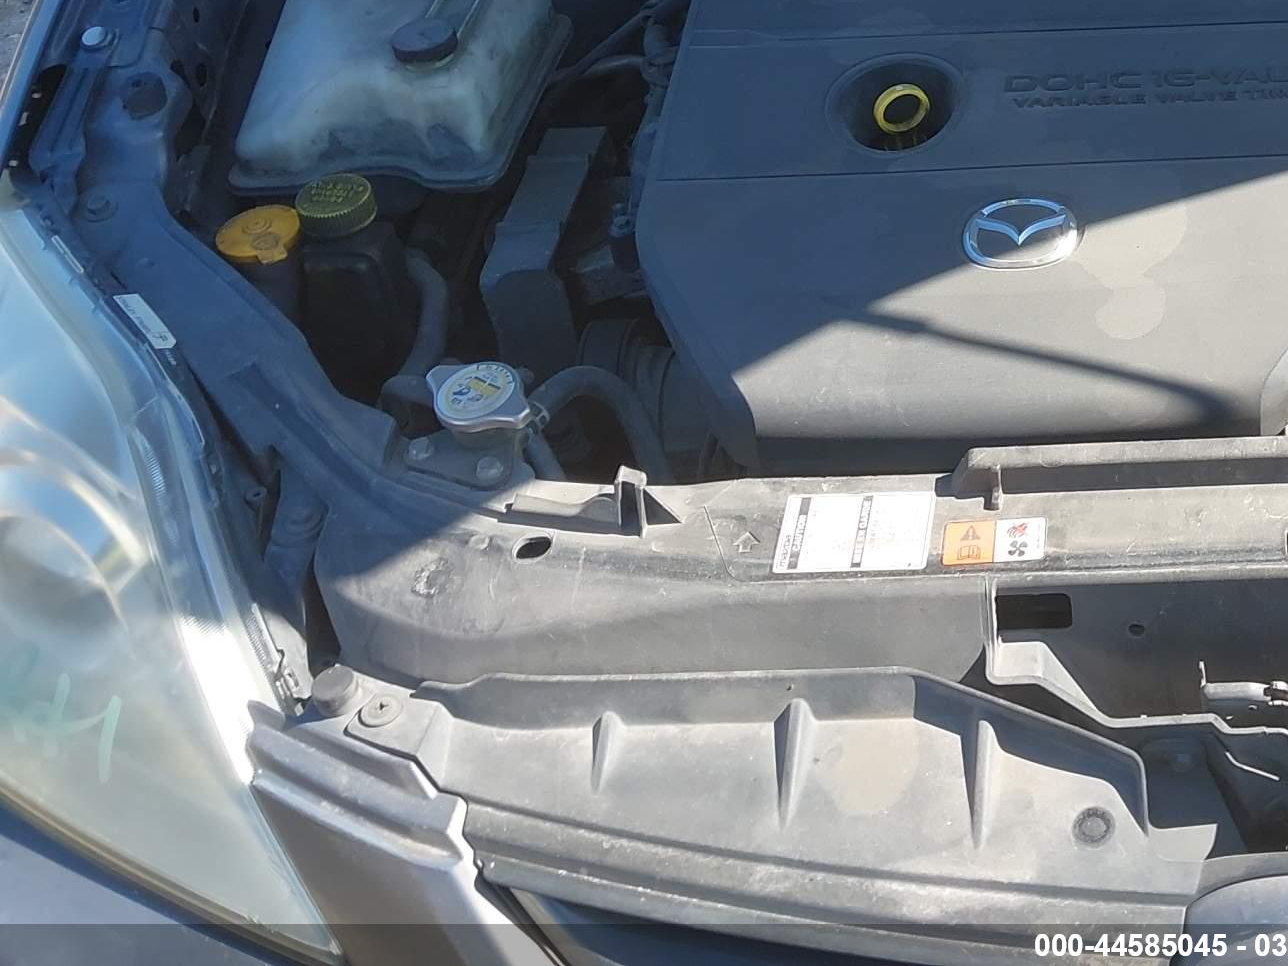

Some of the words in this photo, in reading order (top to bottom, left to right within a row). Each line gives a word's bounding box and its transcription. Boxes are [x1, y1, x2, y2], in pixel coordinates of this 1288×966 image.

[1004, 71, 1142, 93] DOHC
[1012, 92, 1146, 109] VARIABLE
[1156, 89, 1238, 103] VALVE
[792, 514, 807, 552] CAUTION
